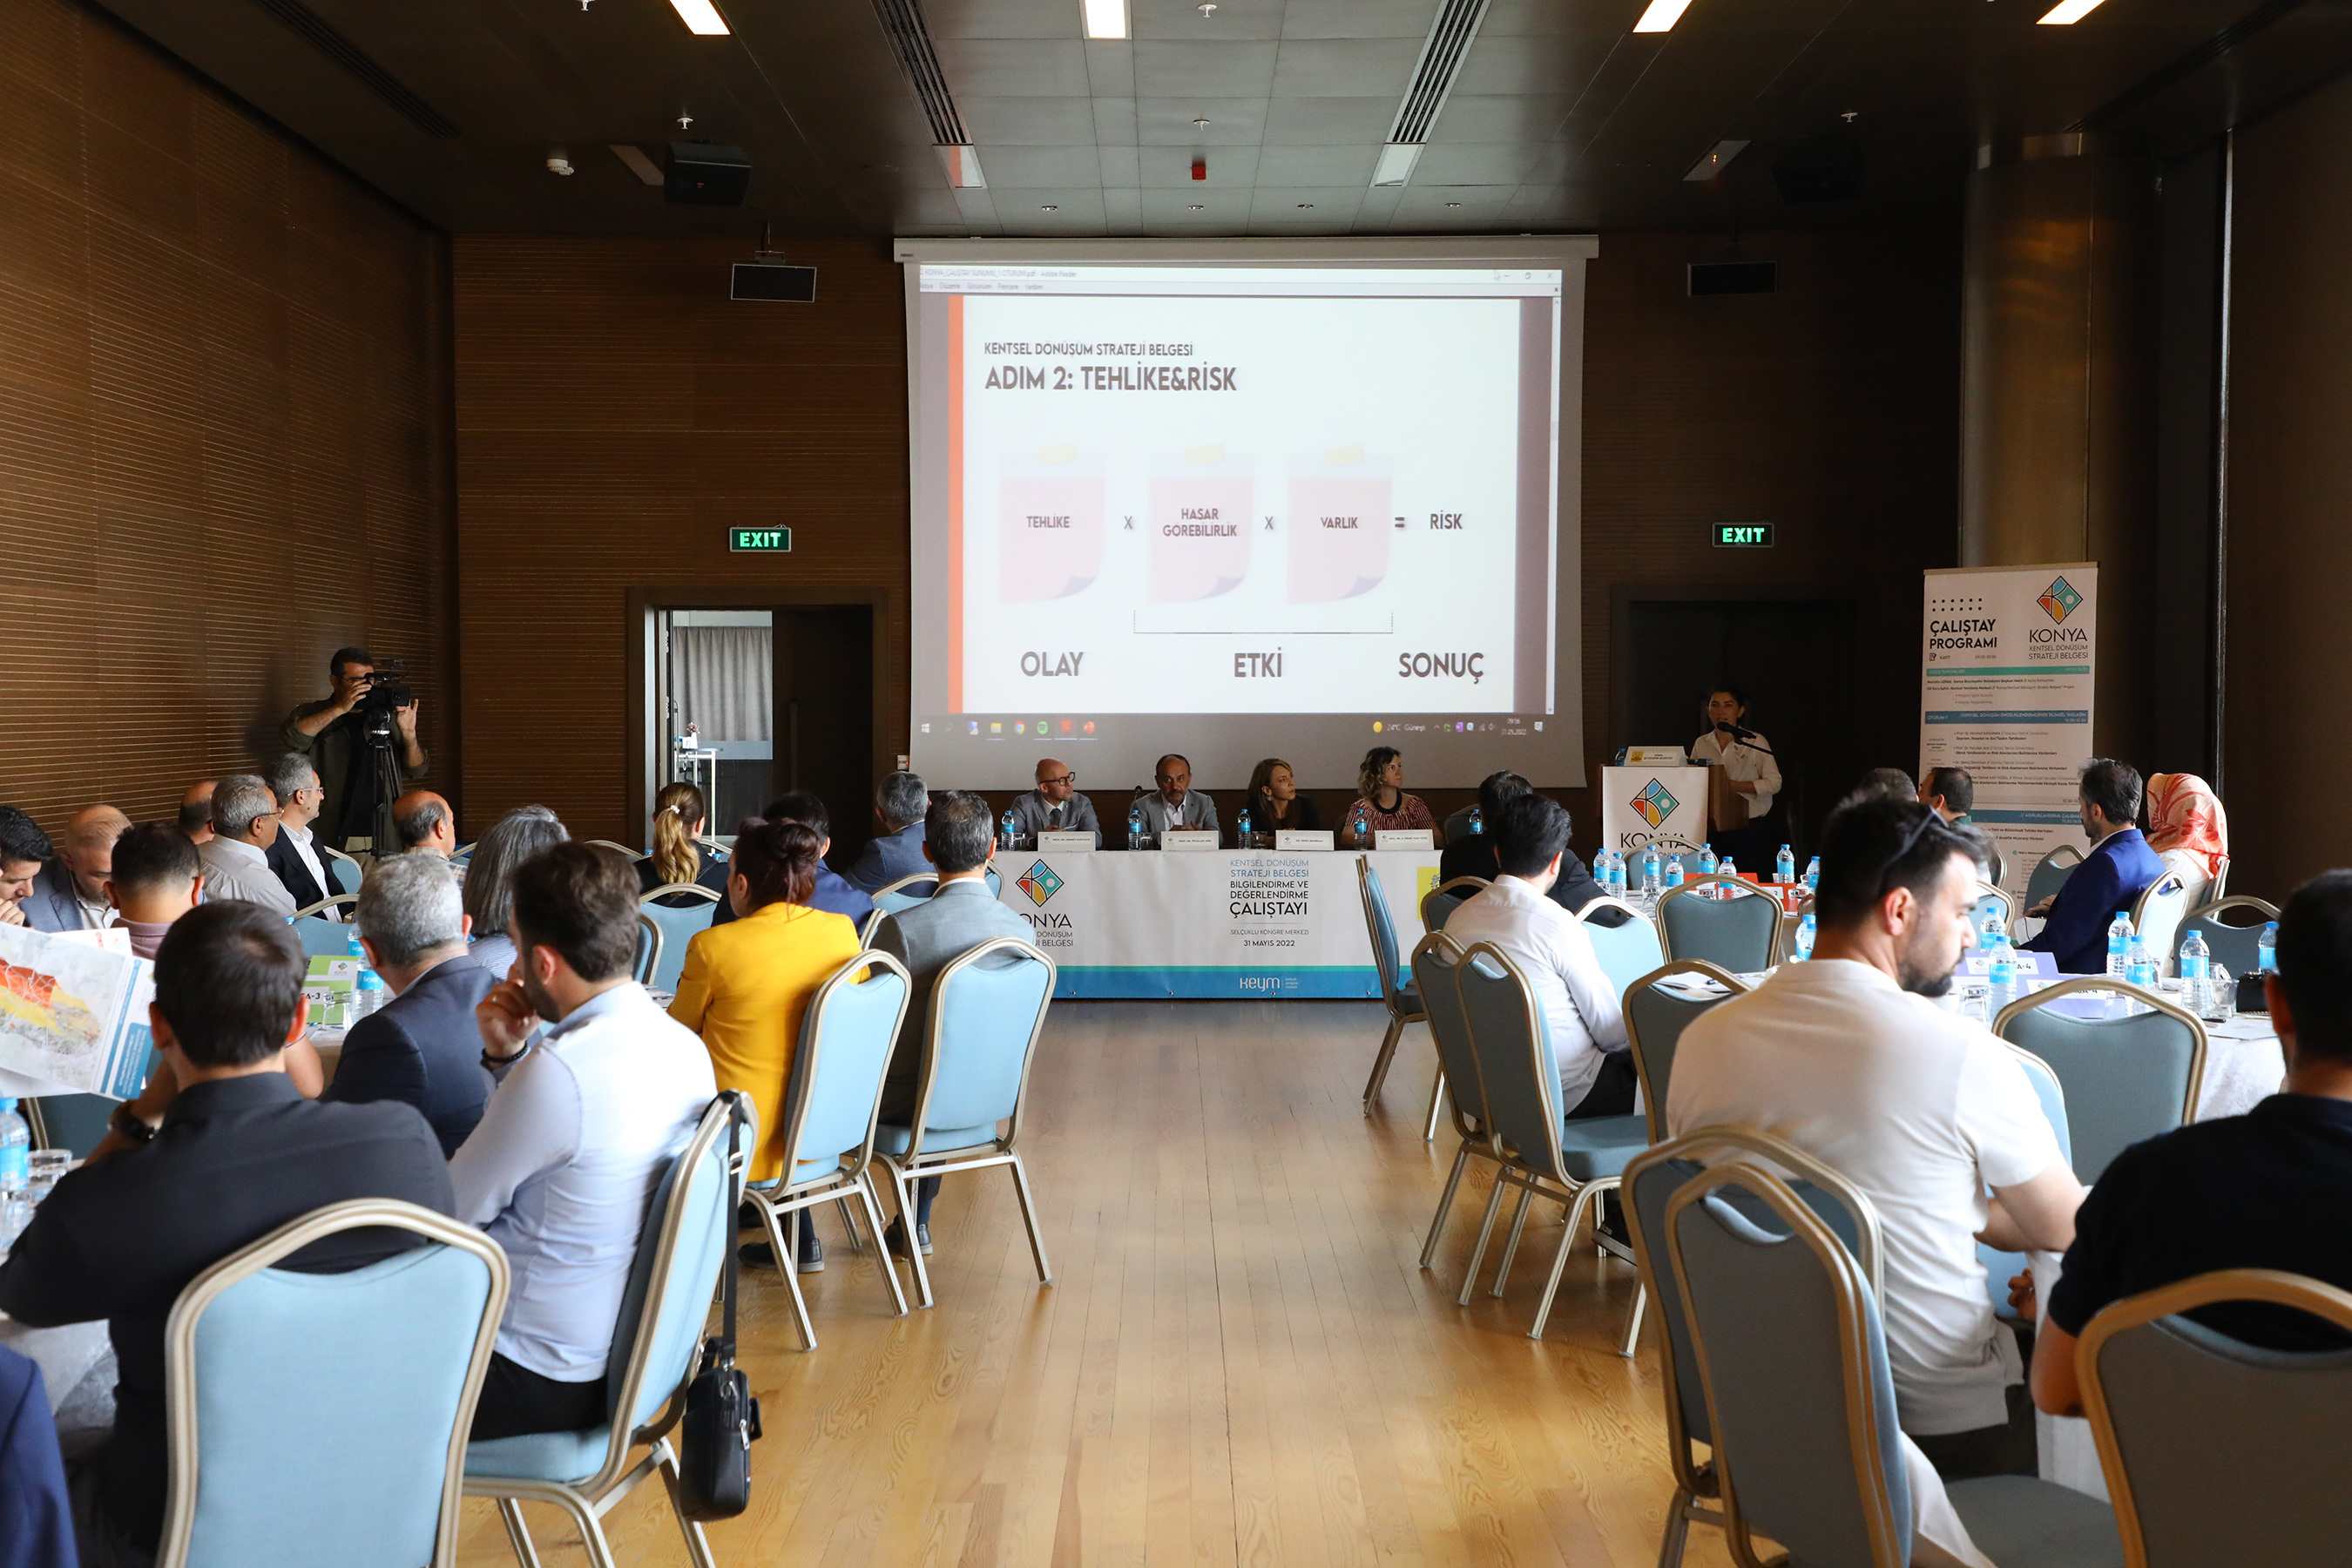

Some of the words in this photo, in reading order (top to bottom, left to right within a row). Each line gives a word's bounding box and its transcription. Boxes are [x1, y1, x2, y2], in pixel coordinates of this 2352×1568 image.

[984, 342, 1032, 355] KENTSEL
[1035, 341, 1093, 358] DÖNÜŞÜM
[1096, 341, 1146, 355] STRATEJİ
[1149, 341, 1193, 356] BELGESİ
[984, 366, 1045, 389] ADIM
[1052, 367, 1073, 389] 2:
[1081, 361, 1236, 391] TEHLİKE&RİSK
[1181, 508, 1219, 520] HASAR
[1026, 513, 1070, 530] TEHLİKE
[1162, 520, 1237, 537] GÖREBİLİRLİK
[1321, 517, 1358, 530] VARLIK
[1429, 510, 1463, 531] RİSK
[740, 532, 781, 547] EXIT
[1722, 527, 1765, 543] EXIT
[1930, 619, 1996, 636] ÇALIŞTAY
[2030, 628, 2088, 643] KONYA
[1930, 637, 1997, 649] PROGRAMI
[1020, 651, 1084, 677] OLAY
[1233, 646, 1283, 678] ETKİ
[1398, 652, 1484, 685] SONUÇ
[1231, 868, 1270, 877] STRATEJİ
[1273, 868, 1308, 877] BELGESİ
[1230, 879, 1294, 889] BİLGİLENDİRME
[1230, 889, 1308, 899] DEĞERLENDİRME
[1229, 902, 1308, 919] ÇALIŞTAYI
[1019, 913, 1072, 929] NYA
